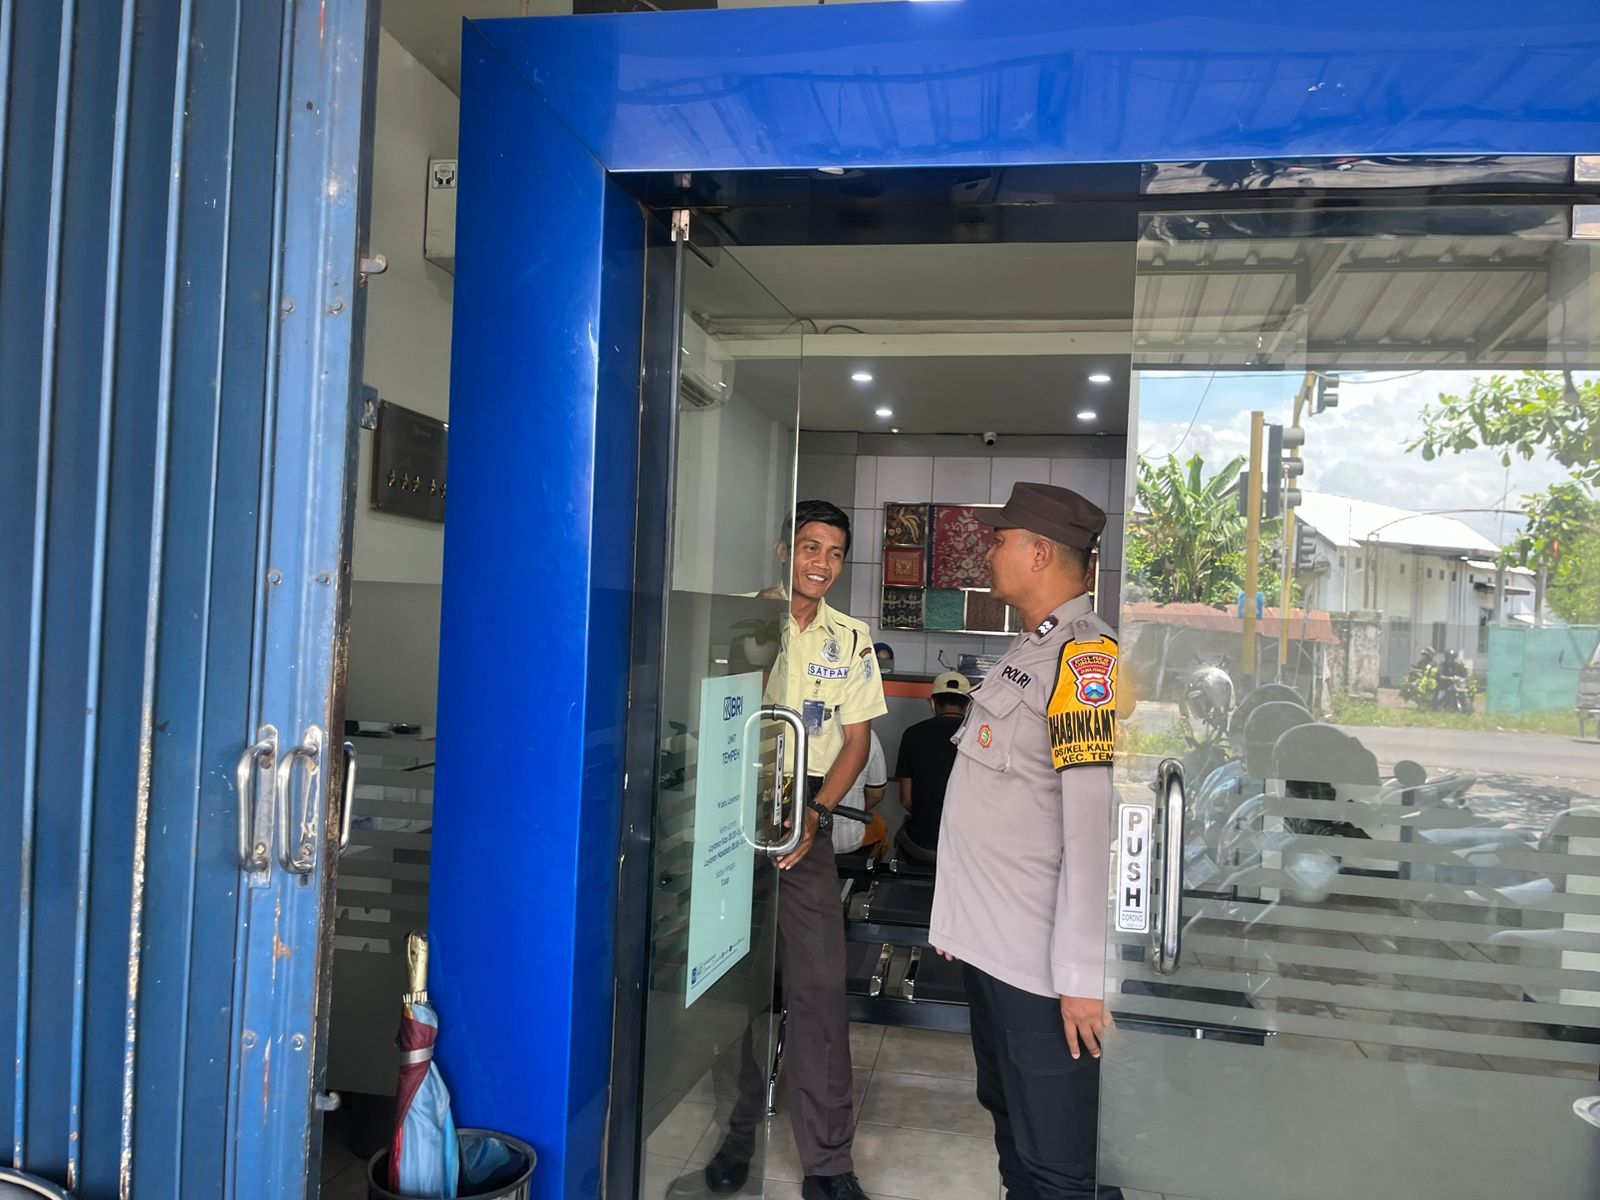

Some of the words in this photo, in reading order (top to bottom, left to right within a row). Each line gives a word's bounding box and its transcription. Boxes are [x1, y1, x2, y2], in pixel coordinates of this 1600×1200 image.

[1001, 665, 1032, 689] POLRI
[1062, 753, 1087, 764] KEC.
[1125, 811, 1143, 907] PUSH
